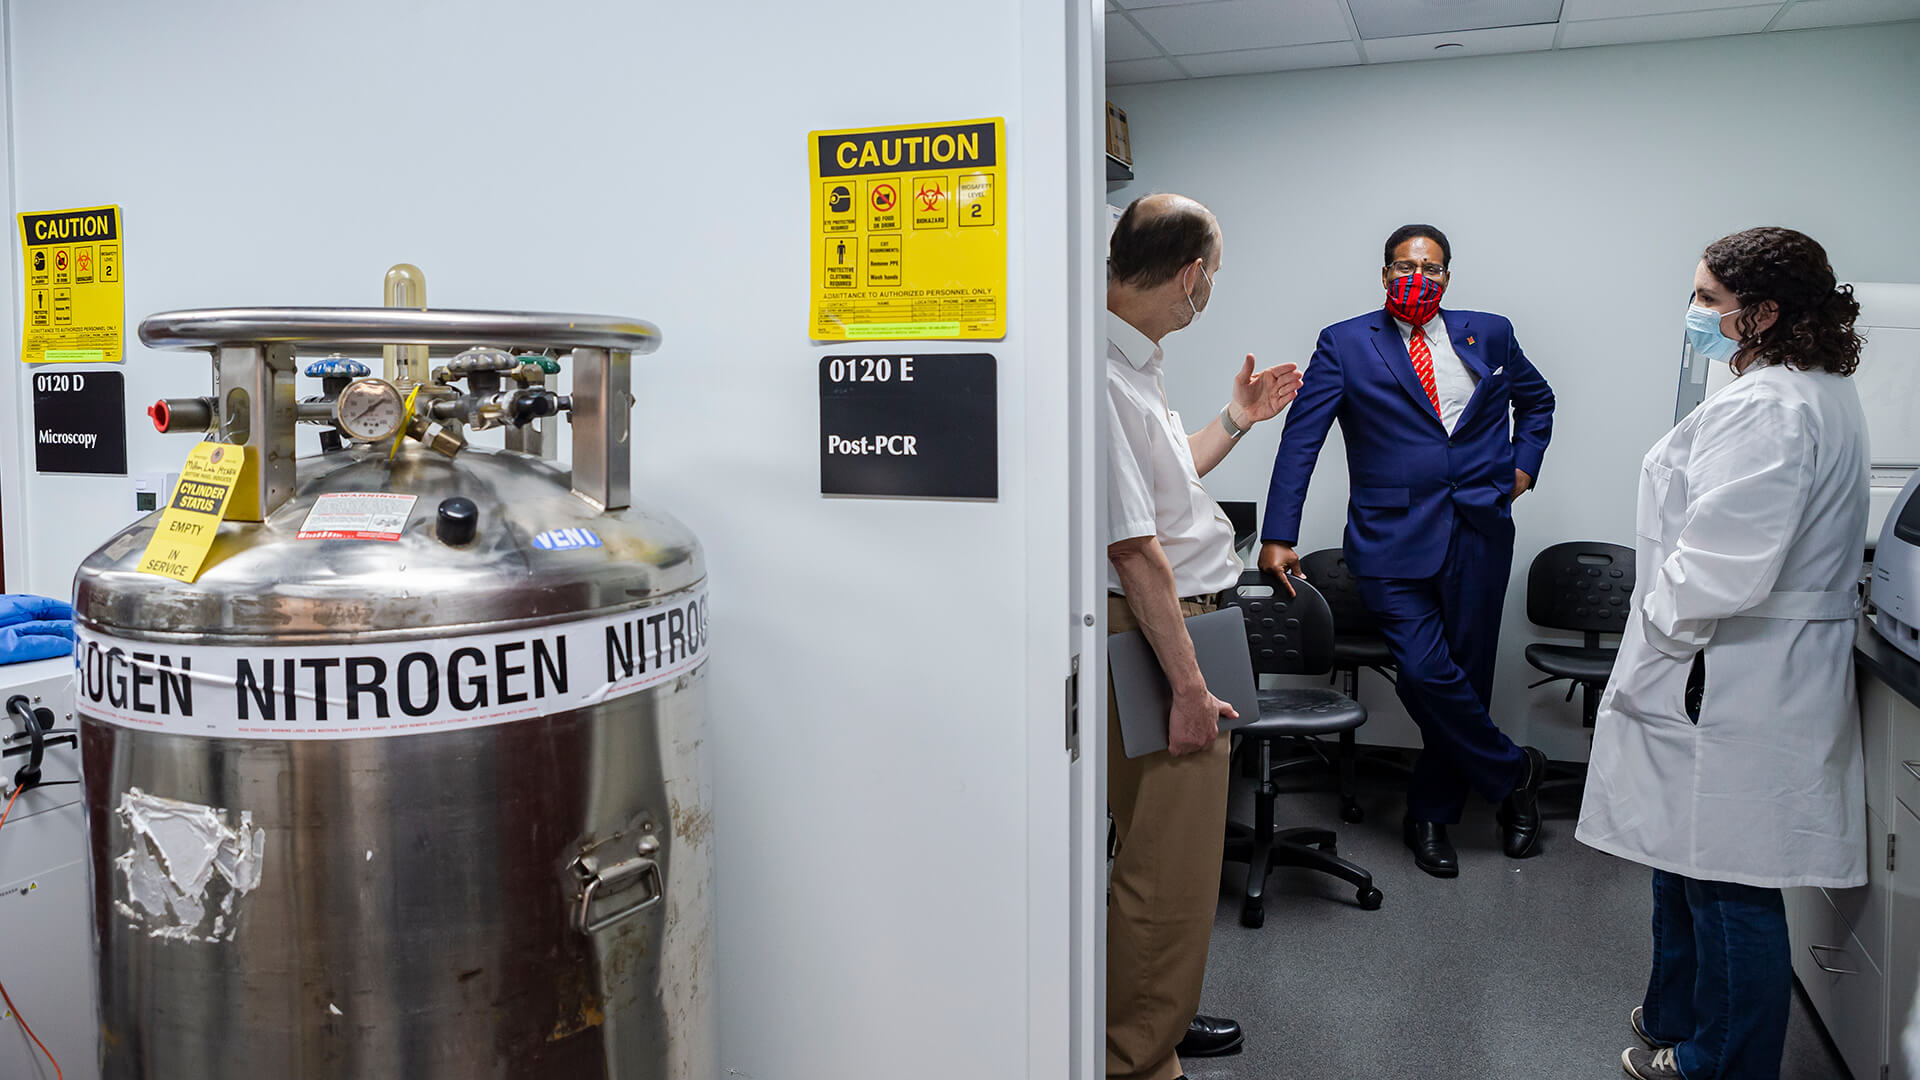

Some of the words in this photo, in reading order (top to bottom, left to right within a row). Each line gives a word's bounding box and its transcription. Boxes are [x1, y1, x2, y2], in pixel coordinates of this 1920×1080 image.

[836, 132, 979, 169] CAUTION
[971, 203, 982, 218] 2
[34, 215, 109, 240] CAUTION
[105, 265, 113, 276] 2
[823, 291, 865, 299] ADMITTANCE
[879, 289, 925, 298] AUTHORIZED
[926, 288, 969, 296] PERSONNEL
[971, 287, 992, 295] ONLY
[829, 358, 892, 382] 0120
[900, 357, 914, 381] E
[37, 374, 70, 392] 0120
[72, 374, 85, 392] D
[38, 428, 98, 449] Microscopy
[828, 435, 918, 455] Post-PCR
[179, 482, 226, 501] CYLINDER
[179, 495, 215, 512] STATUS
[169, 520, 204, 537] EMPTY
[535, 527, 597, 550] VENT
[167, 549, 181, 560] IN
[146, 559, 189, 577] SERVICE
[236, 634, 569, 722] NITROGEN
